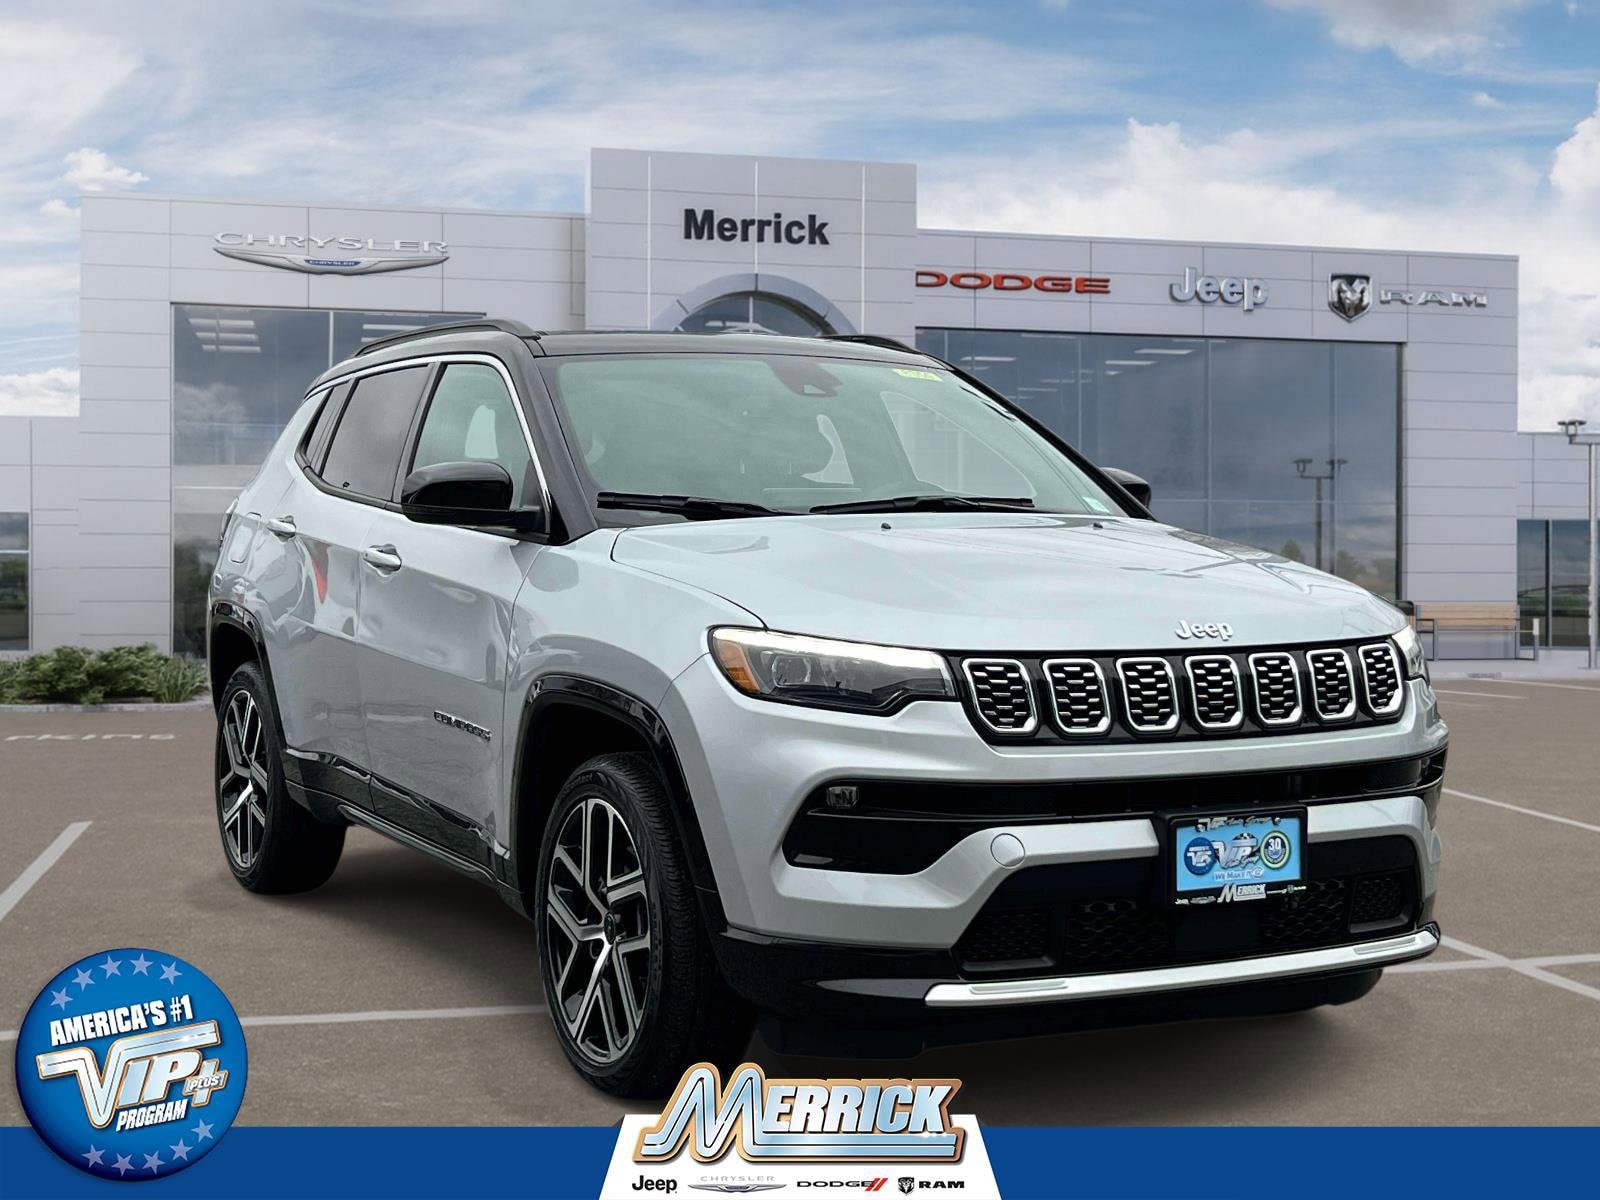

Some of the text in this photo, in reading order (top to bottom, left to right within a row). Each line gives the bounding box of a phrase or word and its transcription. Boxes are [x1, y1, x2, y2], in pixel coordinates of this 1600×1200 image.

[684, 208, 830, 245] Merrick
[214, 232, 449, 254] CHRYSLER
[915, 271, 1111, 294] DODGE
[1169, 267, 1268, 312] Jeep
[1379, 289, 1488, 308] RAM
[1174, 619, 1234, 641] Jeep
[1268, 837, 1282, 851] 30
